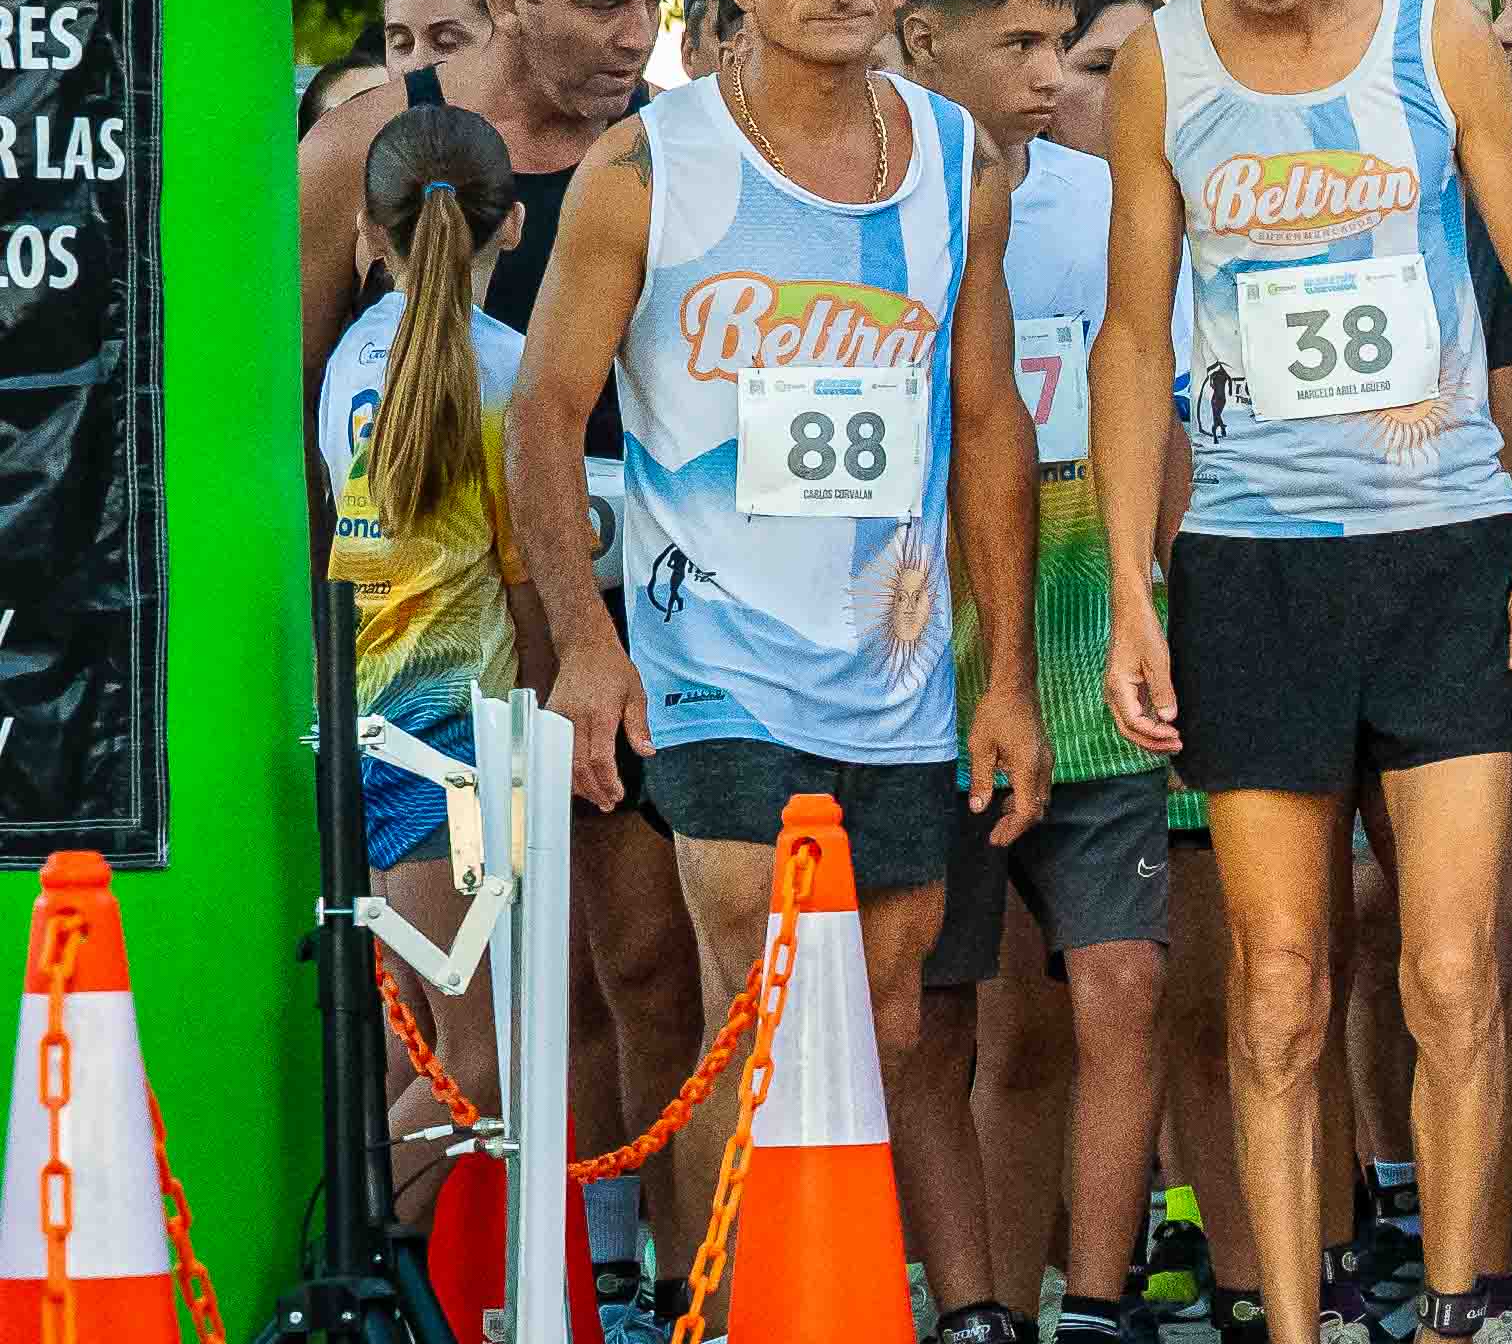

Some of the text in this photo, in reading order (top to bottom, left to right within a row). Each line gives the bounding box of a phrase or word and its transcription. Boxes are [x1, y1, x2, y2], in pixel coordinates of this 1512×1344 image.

[36, 114, 126, 180] LAS
[1207, 158, 1416, 226] Beltrán
[1285, 304, 1395, 382] 38
[787, 411, 888, 481] 88
[803, 489, 833, 500] CARLOS
